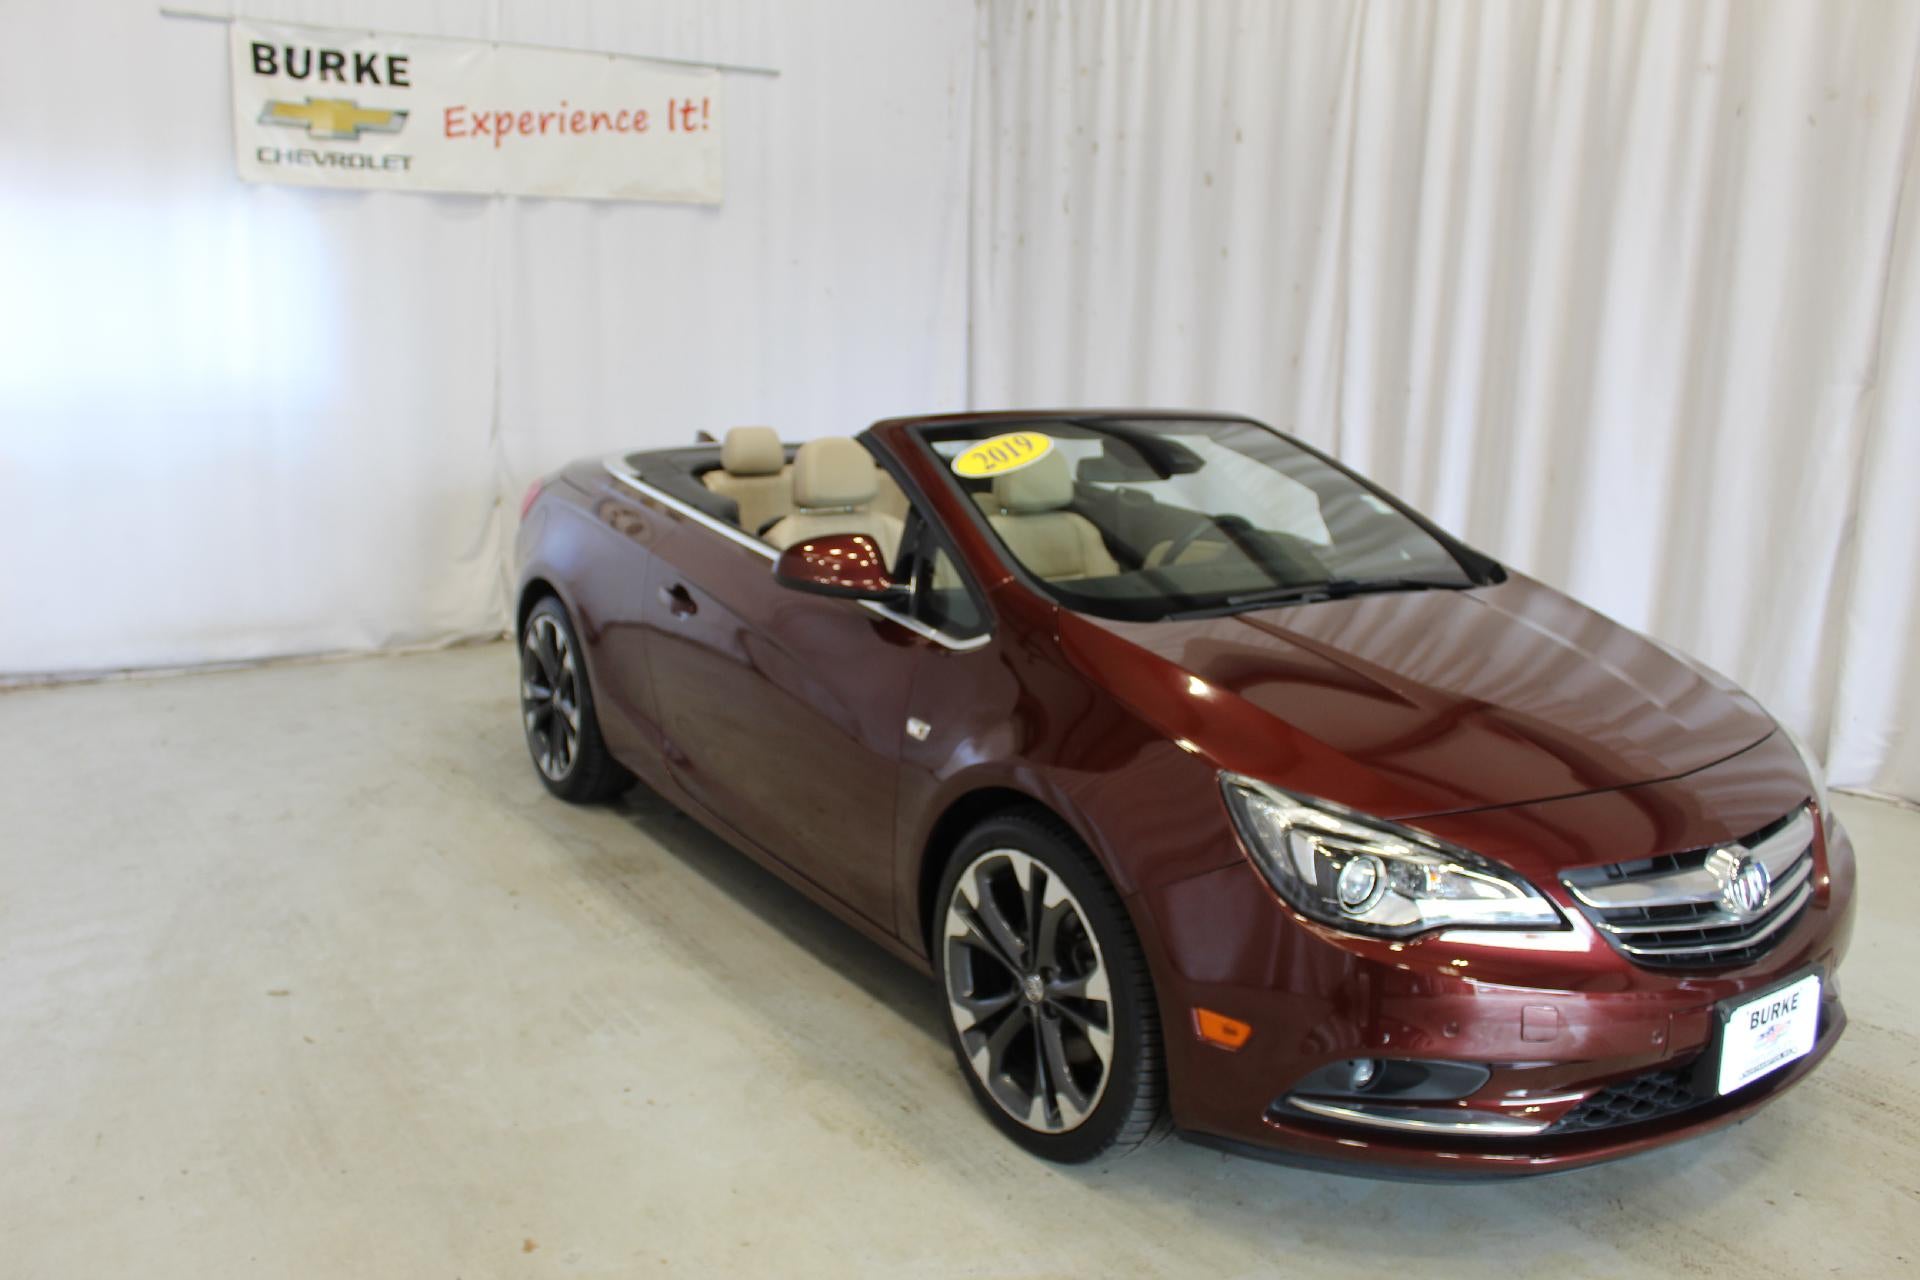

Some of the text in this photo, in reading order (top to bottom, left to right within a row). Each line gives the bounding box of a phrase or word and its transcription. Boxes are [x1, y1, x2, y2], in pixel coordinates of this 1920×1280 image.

[251, 42, 411, 87] BURKE
[443, 98, 711, 148] Experience It!
[256, 146, 413, 171] CHEVROLET
[972, 435, 1033, 469] 2019
[1750, 993, 1798, 1030] BURKE
